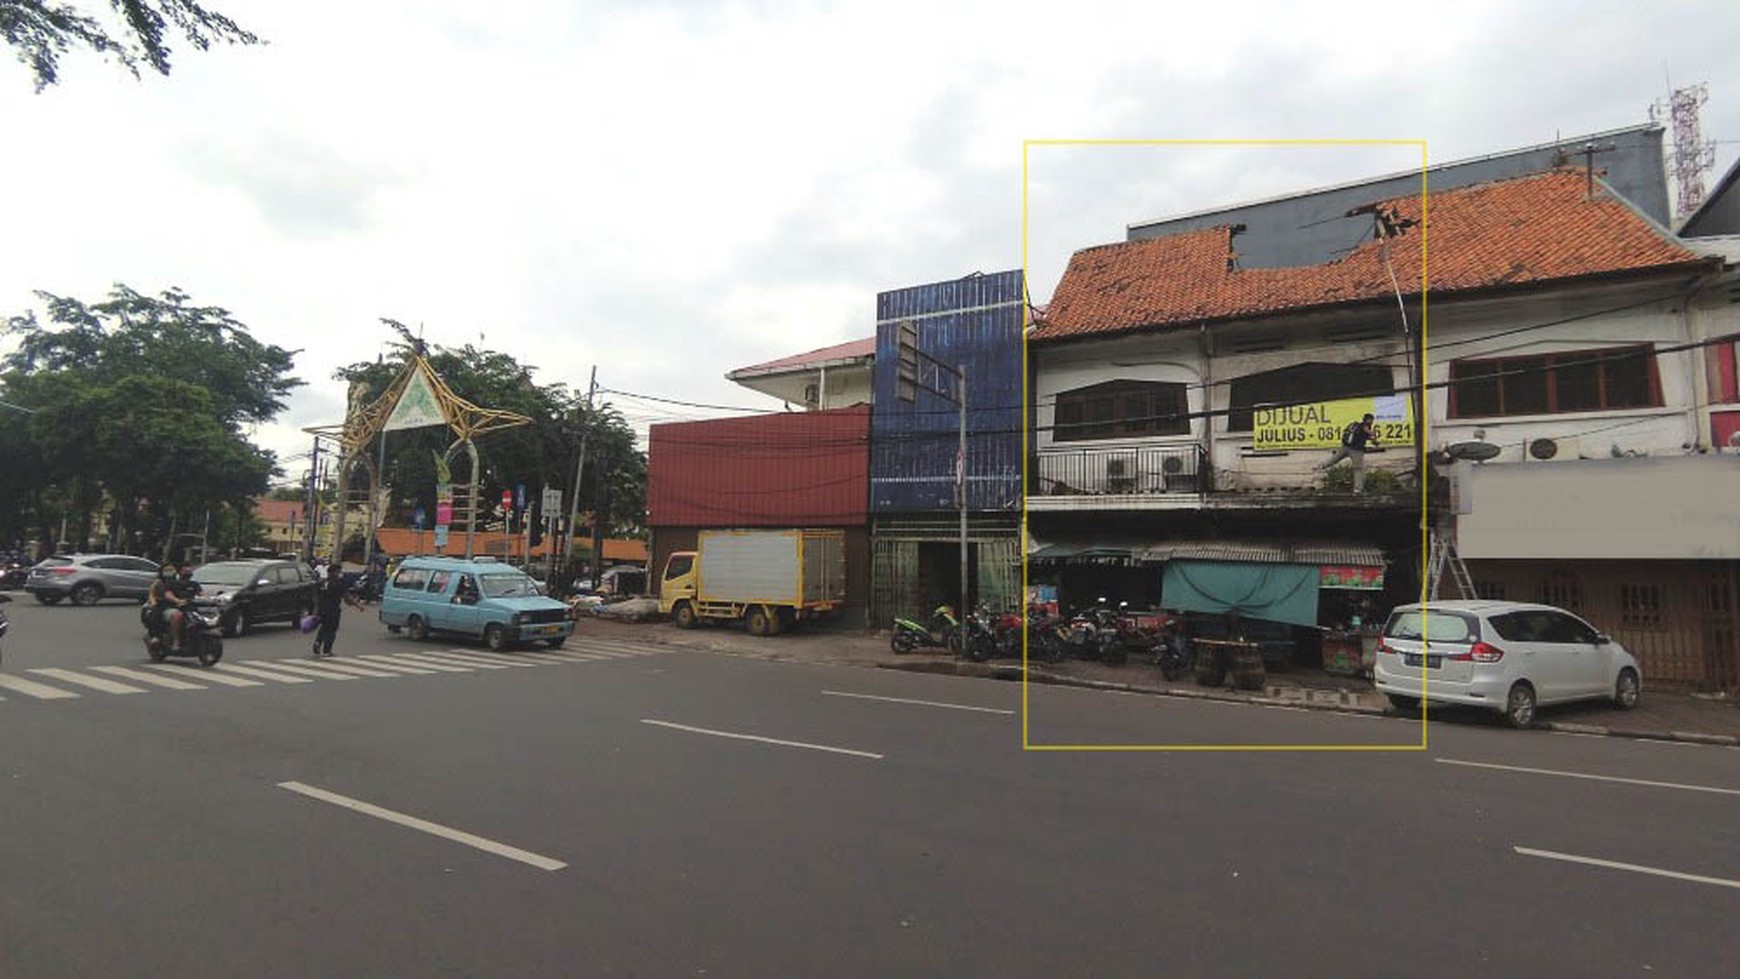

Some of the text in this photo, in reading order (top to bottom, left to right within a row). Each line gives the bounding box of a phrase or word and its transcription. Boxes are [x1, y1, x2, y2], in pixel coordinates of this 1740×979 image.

[1256, 405, 1332, 426] DIJUAL
[1256, 427, 1306, 443] JULIUS
[1386, 423, 1411, 439] 221
